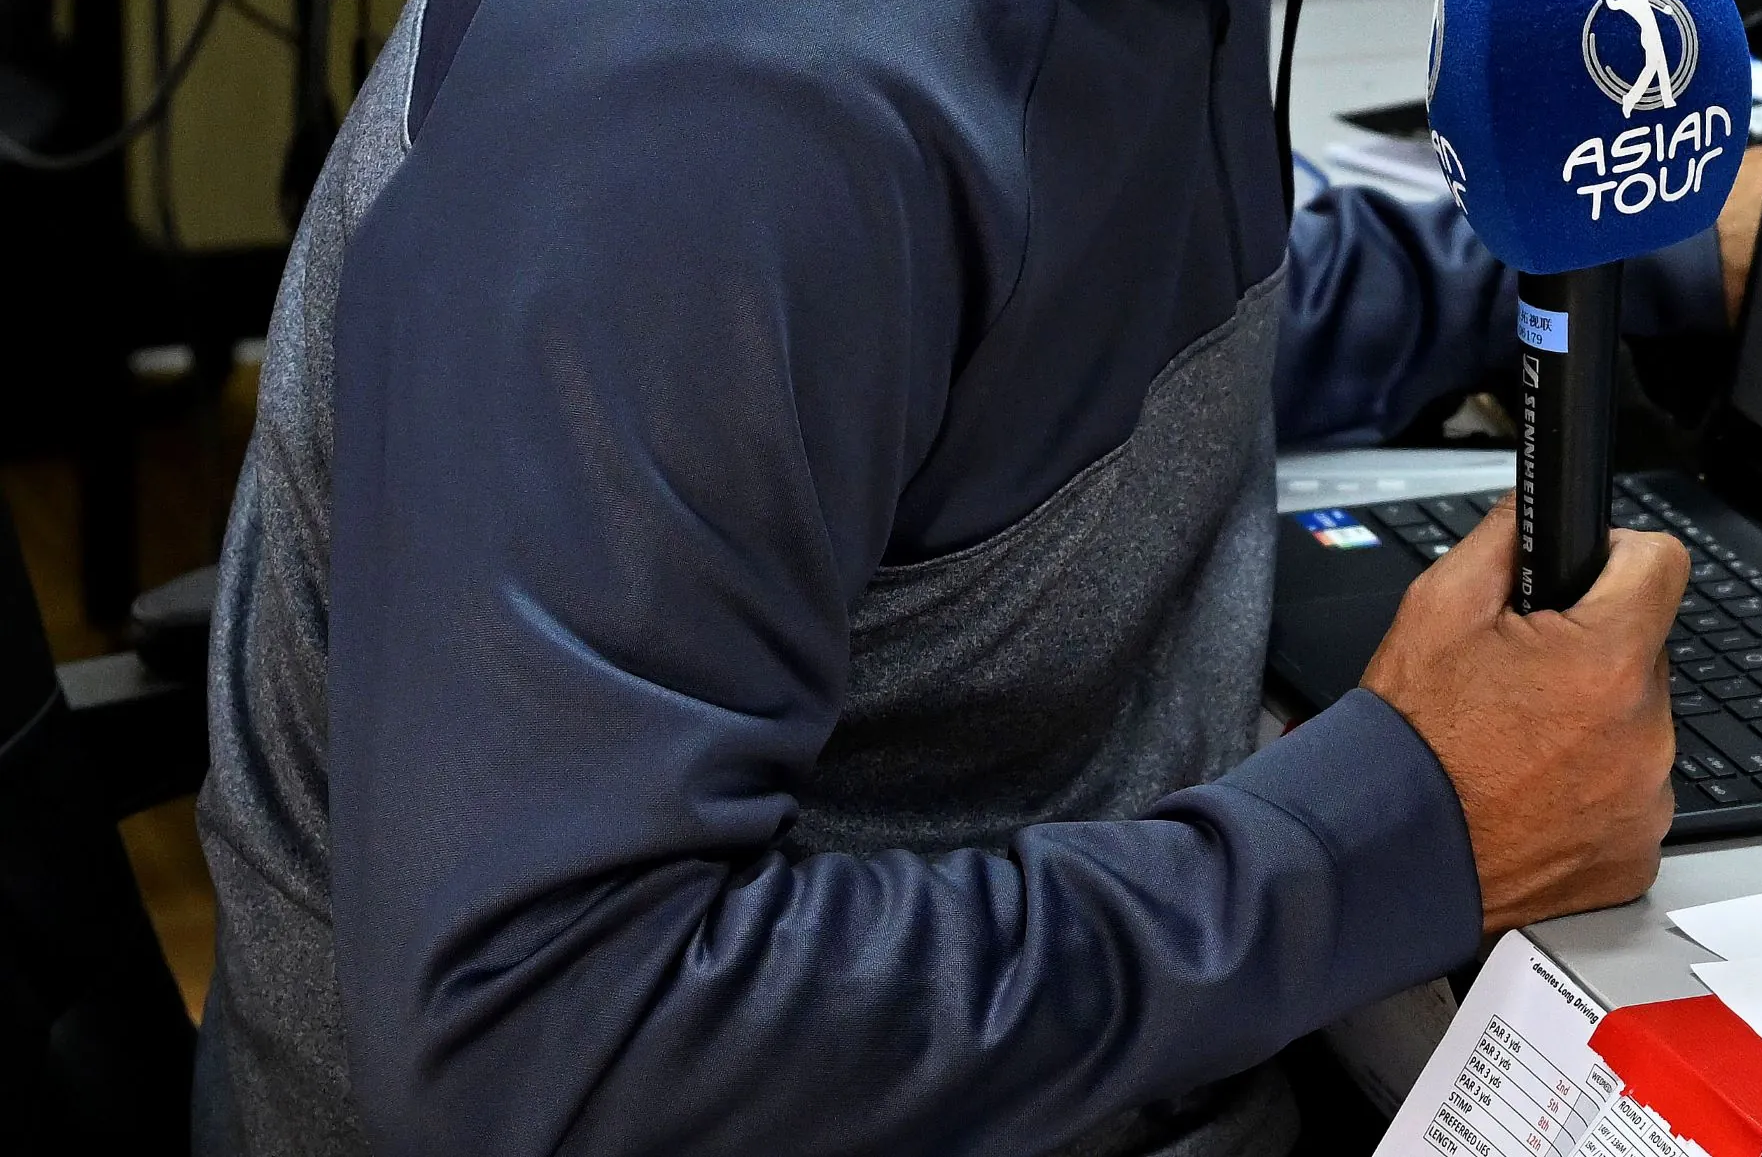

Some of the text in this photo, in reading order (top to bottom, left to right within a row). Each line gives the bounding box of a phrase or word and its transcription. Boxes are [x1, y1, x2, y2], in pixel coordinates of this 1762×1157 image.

[1577, 147, 1724, 221] TOUR
[1522, 392, 1536, 554] SENNHEISER
[1532, 962, 1600, 1025] denotes Long Driving
[1478, 1038, 1495, 1057] PAR
[1499, 1055, 1512, 1071] yds
[1546, 1098, 1560, 1114] 5th
[1488, 1020, 1506, 1038] PAR
[1509, 1037, 1522, 1054] yds
[1555, 1079, 1572, 1096] 2nd
[1447, 1091, 1474, 1115] STIMP
[1458, 1073, 1476, 1092] PAR
[1479, 1090, 1492, 1107] yds
[1525, 1132, 1542, 1152] 12th
[1468, 1056, 1486, 1074] PAR
[1489, 1073, 1502, 1089] yds
[1537, 1116, 1550, 1132] 8th
[1617, 1100, 1642, 1126] ROUND
[1427, 1126, 1459, 1156] LENGTH
[1437, 1108, 1491, 1157] PREFERRED LIES
[1648, 1131, 1673, 1156] ROUND
